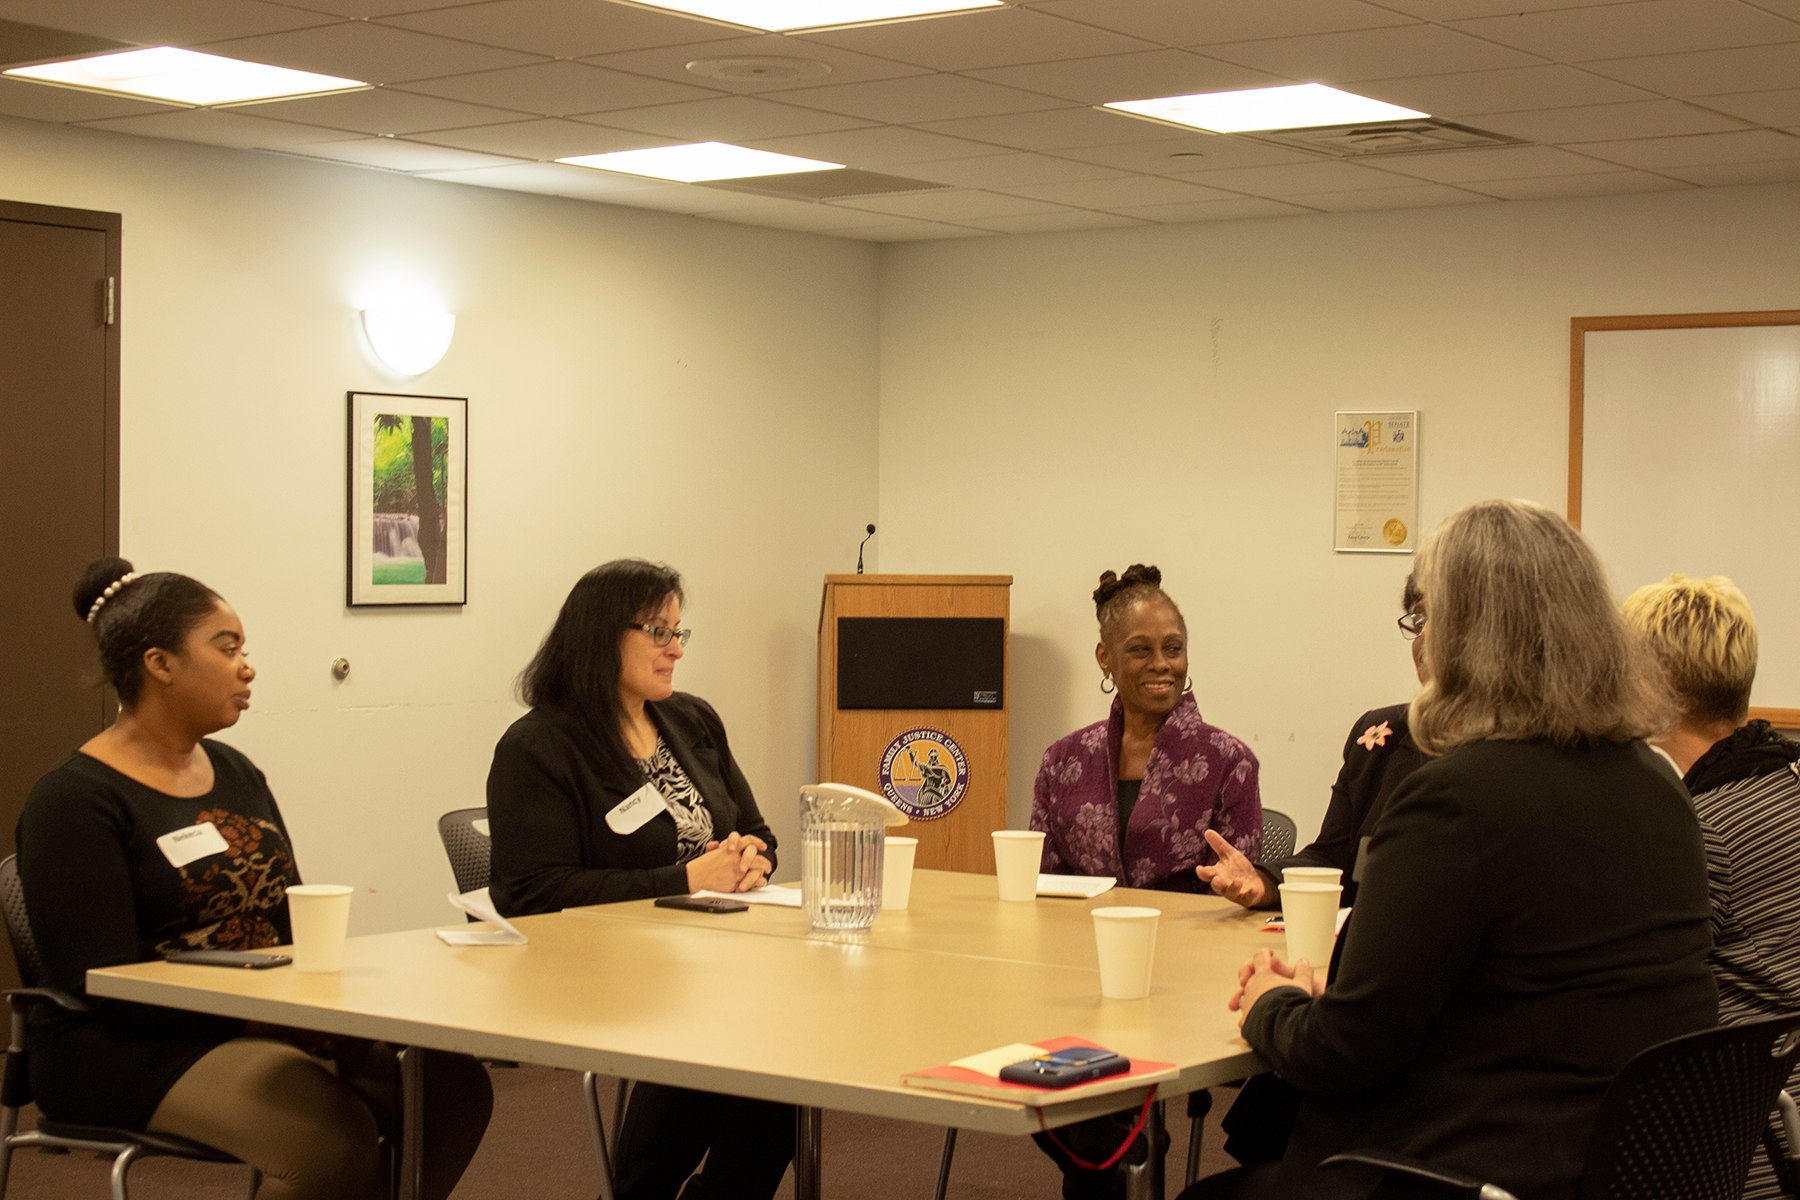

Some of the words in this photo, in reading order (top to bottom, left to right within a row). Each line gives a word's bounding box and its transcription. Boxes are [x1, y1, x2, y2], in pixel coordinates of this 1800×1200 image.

[882, 740, 902, 776] FAMILY
[902, 731, 944, 744] JUSTICE
[944, 739, 966, 776] CENTER
[618, 796, 641, 815] Nancy
[883, 783, 913, 814] QUEENS
[923, 804, 943, 816] NEW
[944, 782, 965, 807] YORK
